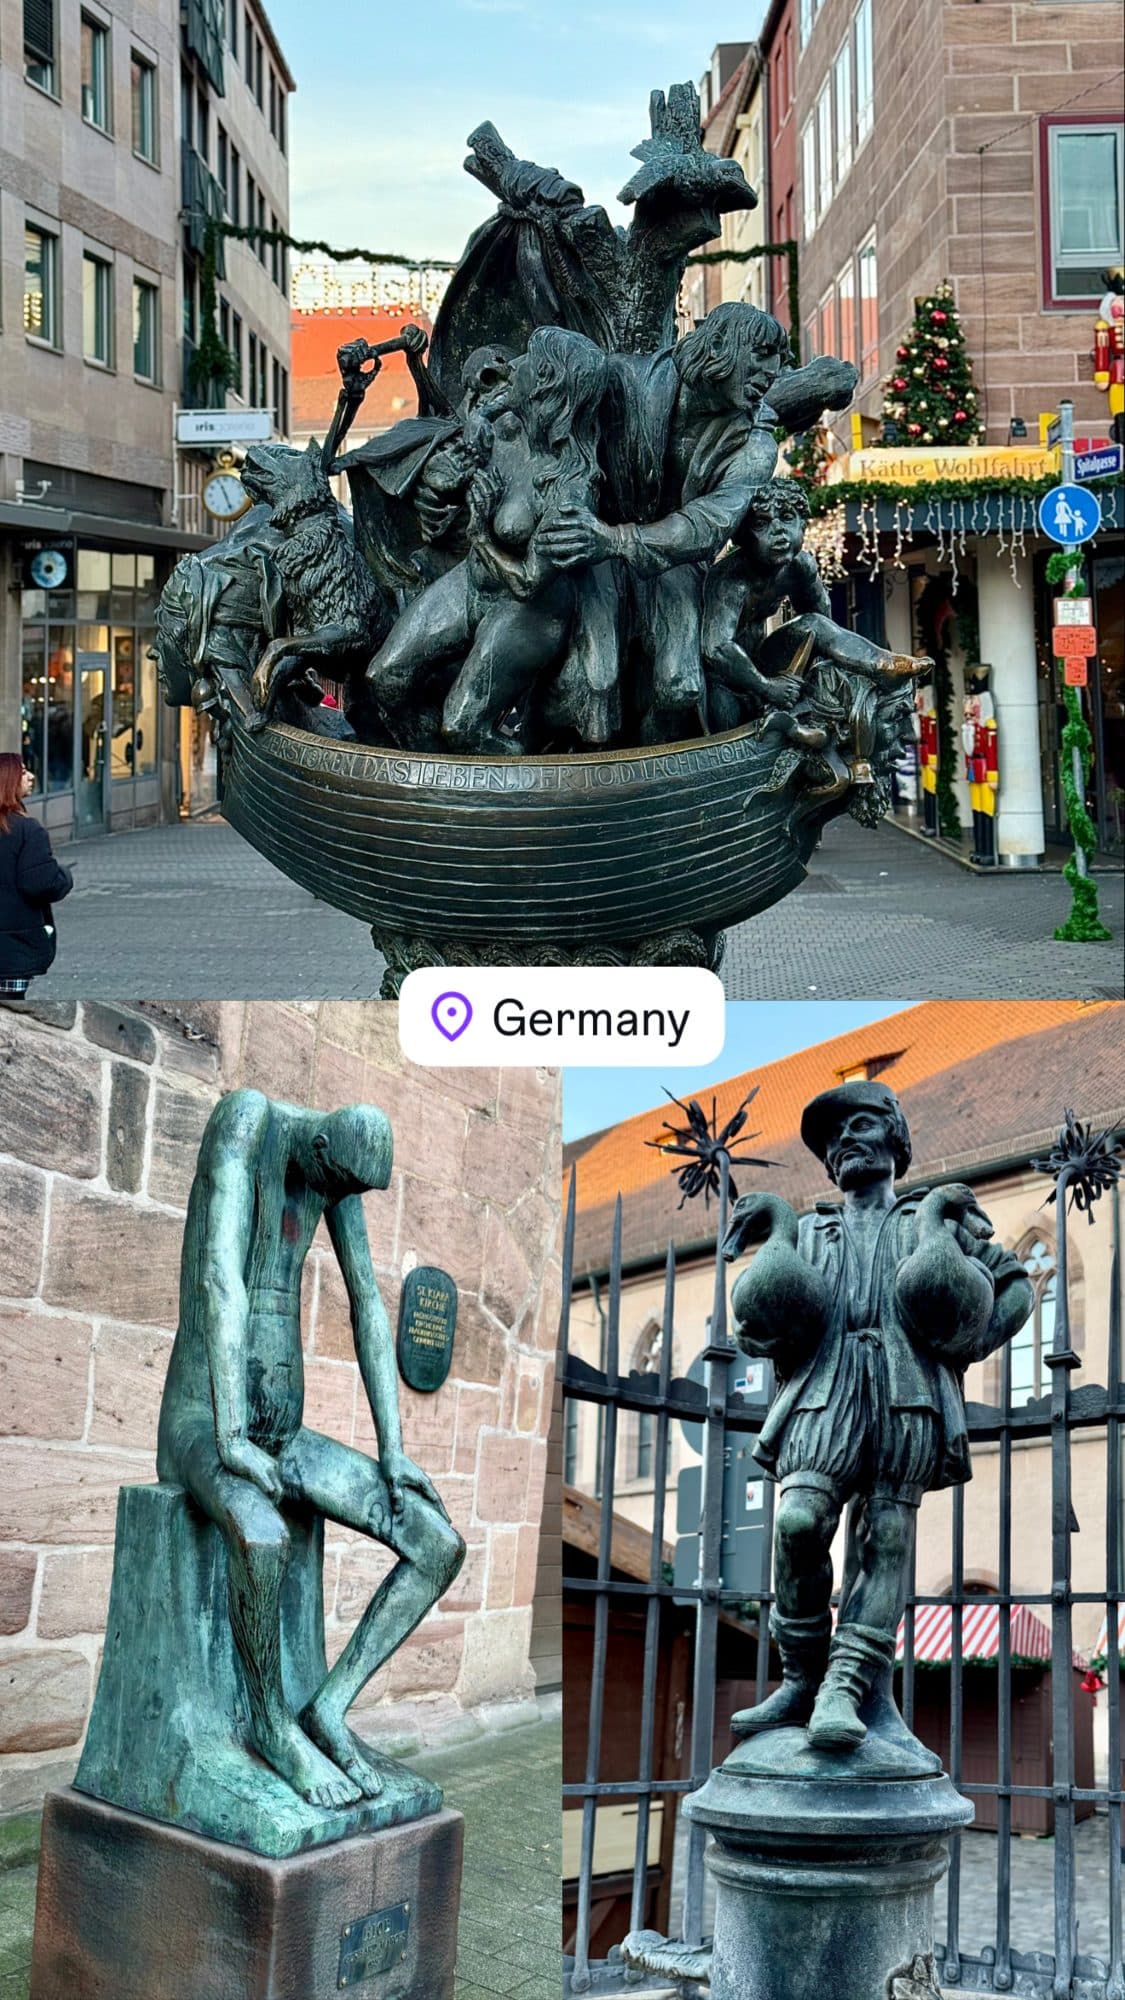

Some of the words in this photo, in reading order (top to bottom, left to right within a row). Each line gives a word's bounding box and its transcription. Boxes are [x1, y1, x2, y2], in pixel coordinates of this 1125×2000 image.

[860, 459, 924, 478] Käthe
[933, 456, 1046, 477] Wohlfahrt
[1077, 455, 1117, 477] Spitalgasse
[363, 755, 410, 783] DAS
[519, 766, 577, 791] DER
[580, 762, 635, 789] TOD
[641, 751, 701, 780] LACHT
